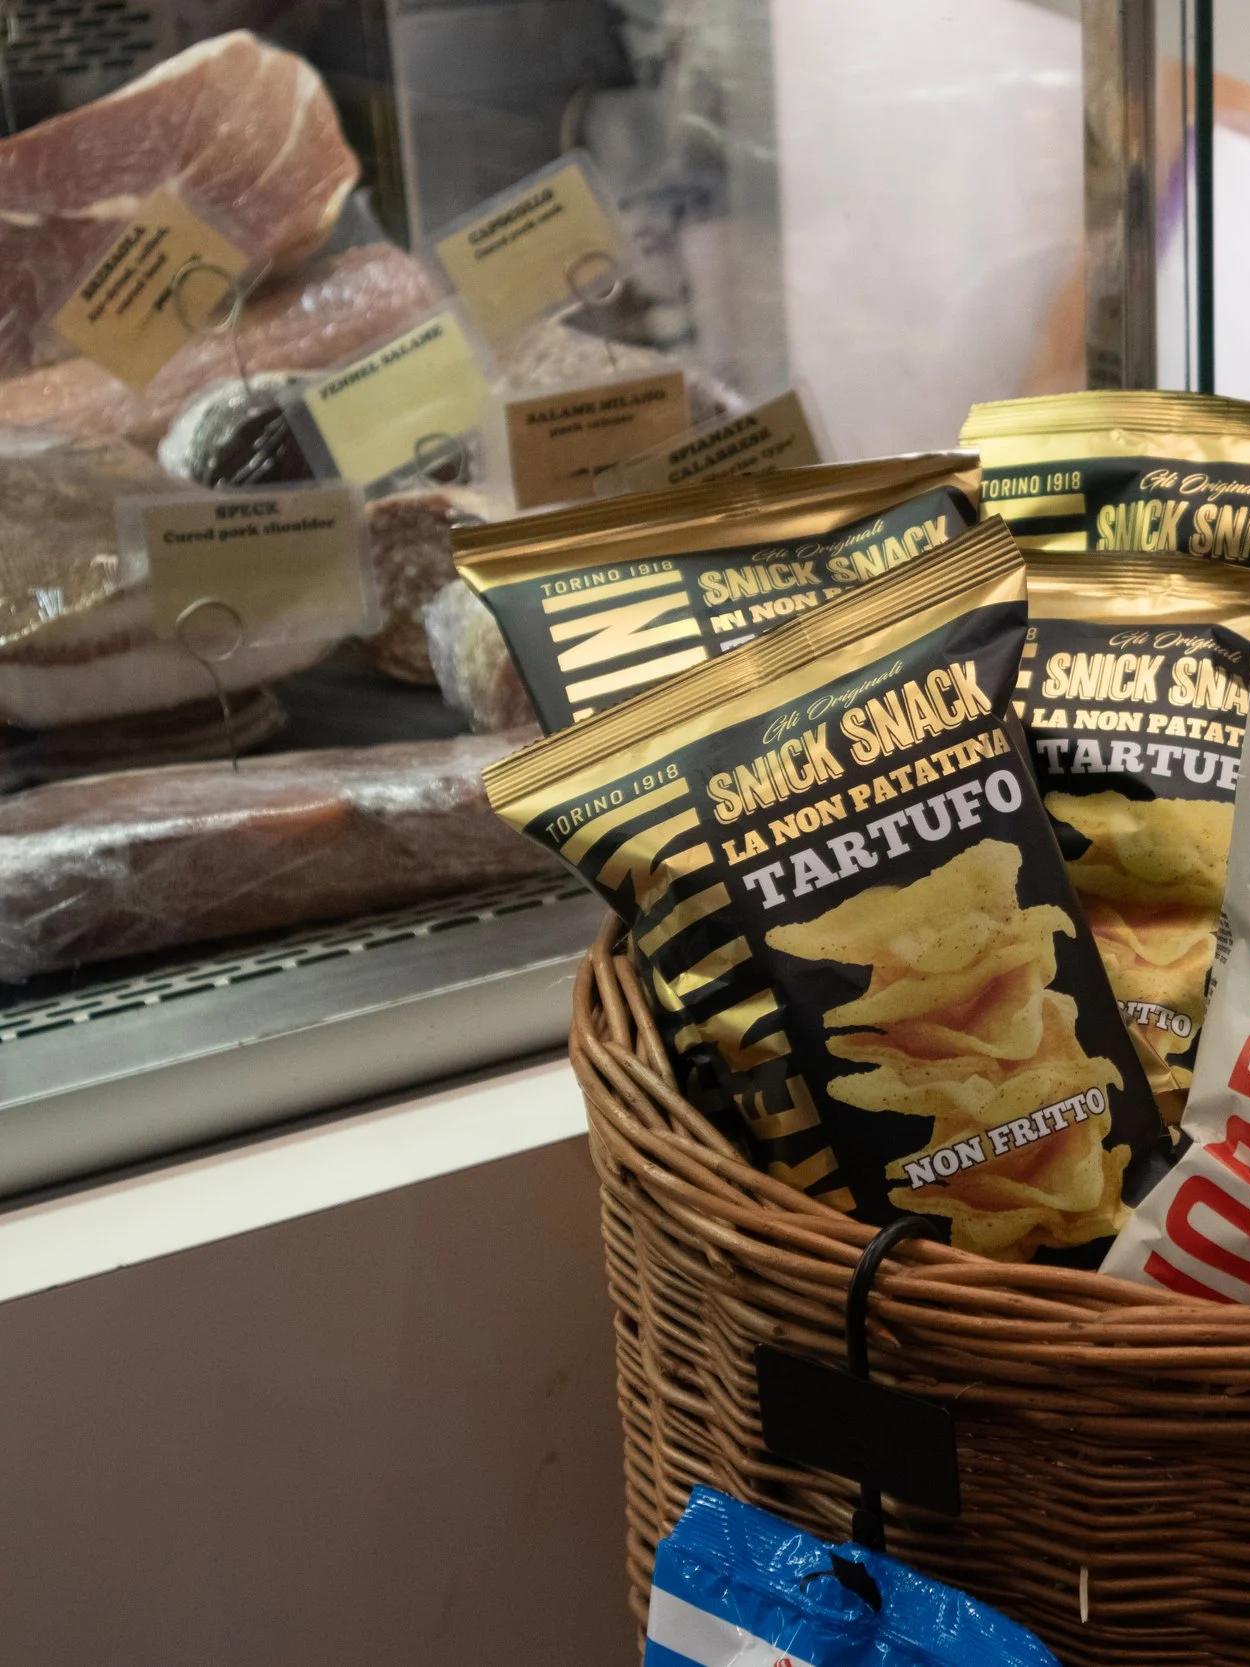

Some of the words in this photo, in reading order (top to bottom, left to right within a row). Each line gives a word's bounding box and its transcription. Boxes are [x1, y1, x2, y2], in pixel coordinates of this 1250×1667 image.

[981, 475, 1040, 499] TORINO
[1046, 470, 1082, 492] 1918
[1139, 469, 1177, 491] Gli
[163, 529, 214, 545] Cured
[219, 524, 258, 543] pork
[263, 517, 335, 535] shoulder
[215, 501, 279, 520] SPECK
[1096, 499, 1190, 552] SNICK
[698, 559, 823, 608] SNICK
[826, 515, 950, 583] SNACK
[797, 519, 886, 560] Originali
[540, 567, 620, 597] TORINO
[630, 559, 674, 579] 1918
[1109, 630, 1150, 650] Gli
[1153, 630, 1243, 664] Originali
[762, 712, 801, 745] Gli
[805, 658, 905, 722] Originali
[1042, 652, 1165, 703] SNICK
[1168, 656, 1250, 716] SNA
[707, 726, 844, 824] SNICK
[840, 659, 994, 767] SNACK
[1031, 708, 1068, 729] LA
[1073, 709, 1144, 732] NON
[1146, 713, 1246, 748] PATAT
[1036, 738, 1241, 791] TARTUF
[545, 789, 624, 843] TORINO
[632, 763, 680, 795] 1918
[722, 831, 769, 868] LA
[769, 797, 848, 850] NON
[853, 727, 1013, 811] PATATINA
[742, 769, 1023, 912] TARTUFO
[1118, 1000, 1193, 1039] ITTO
[904, 1141, 985, 1191] NON
[992, 1087, 1107, 1157] FRITTO
